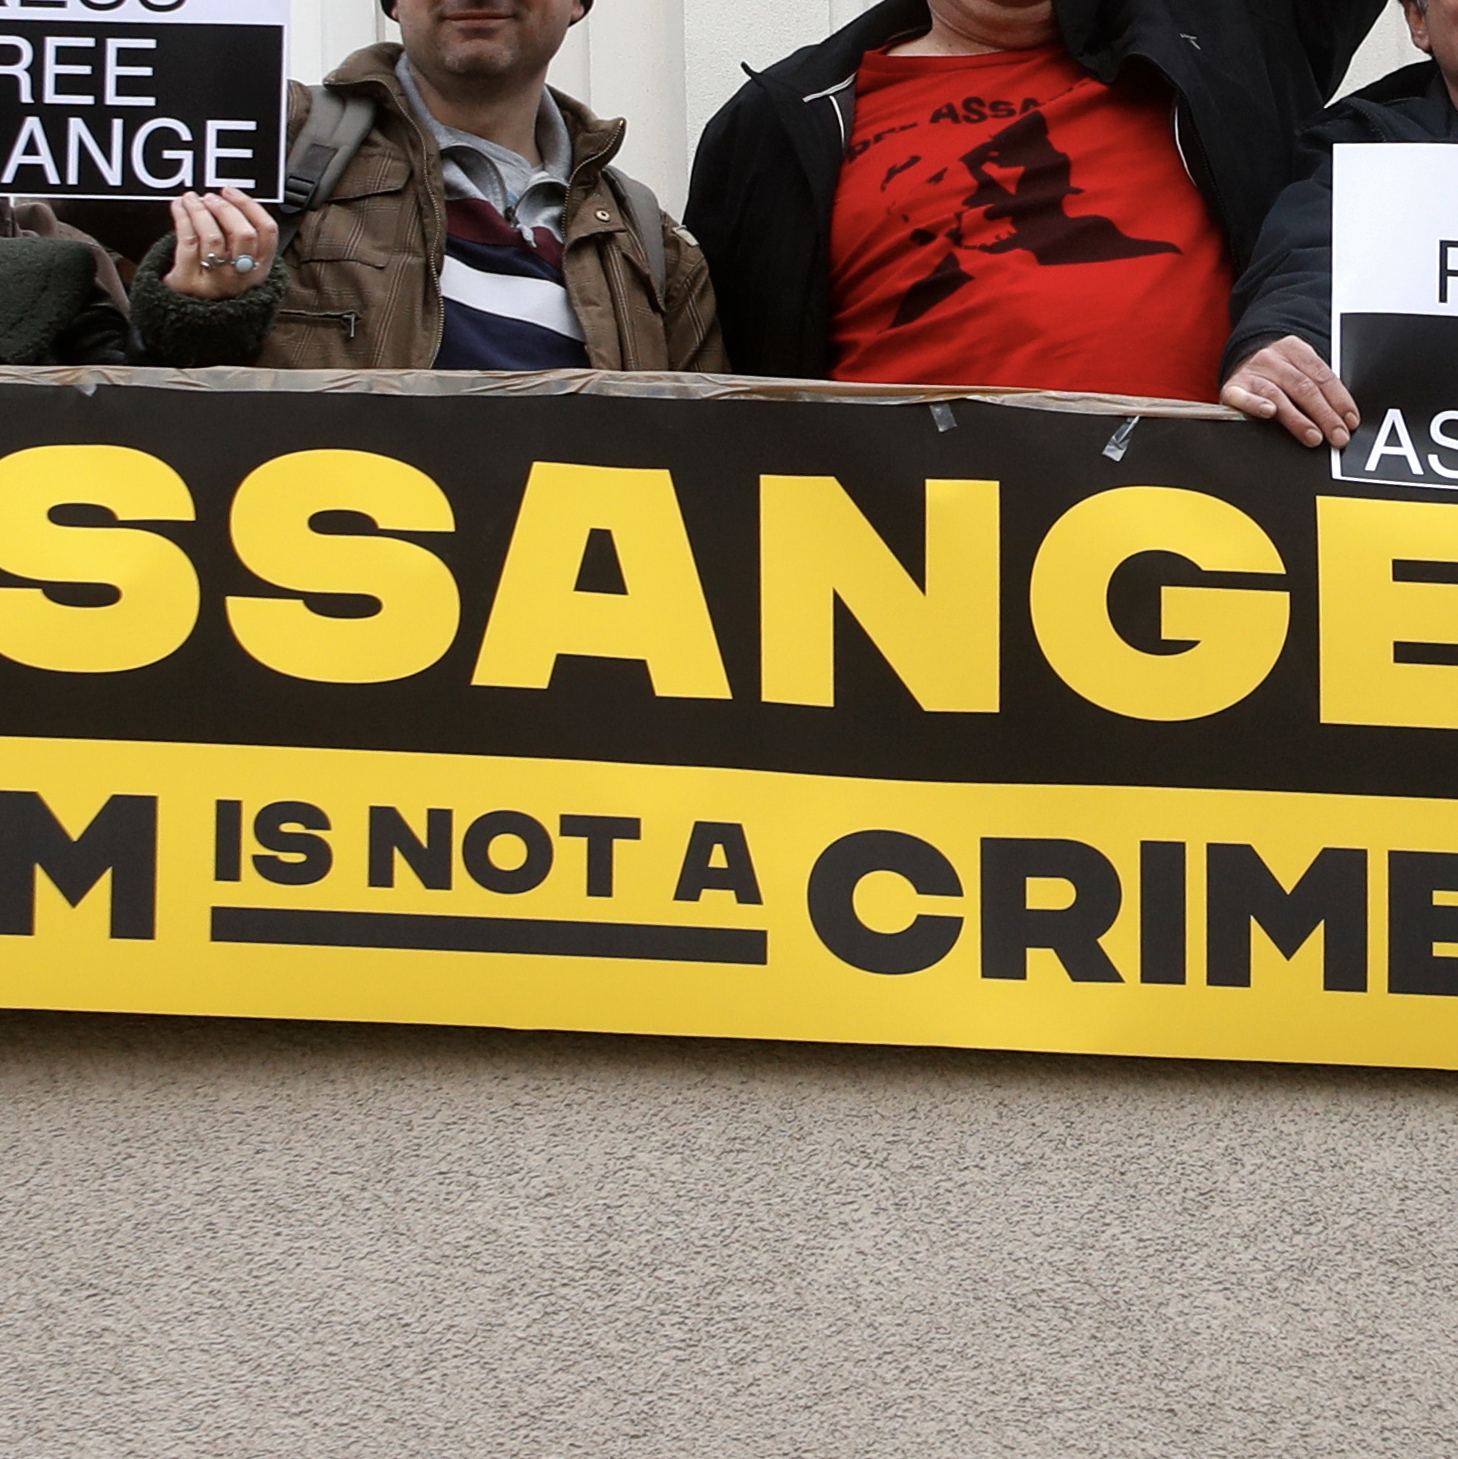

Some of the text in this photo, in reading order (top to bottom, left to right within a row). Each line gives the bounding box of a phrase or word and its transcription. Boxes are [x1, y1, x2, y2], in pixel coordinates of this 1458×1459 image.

[214, 799, 333, 886] IS
[367, 804, 642, 898] NOT
[672, 821, 763, 905] A
